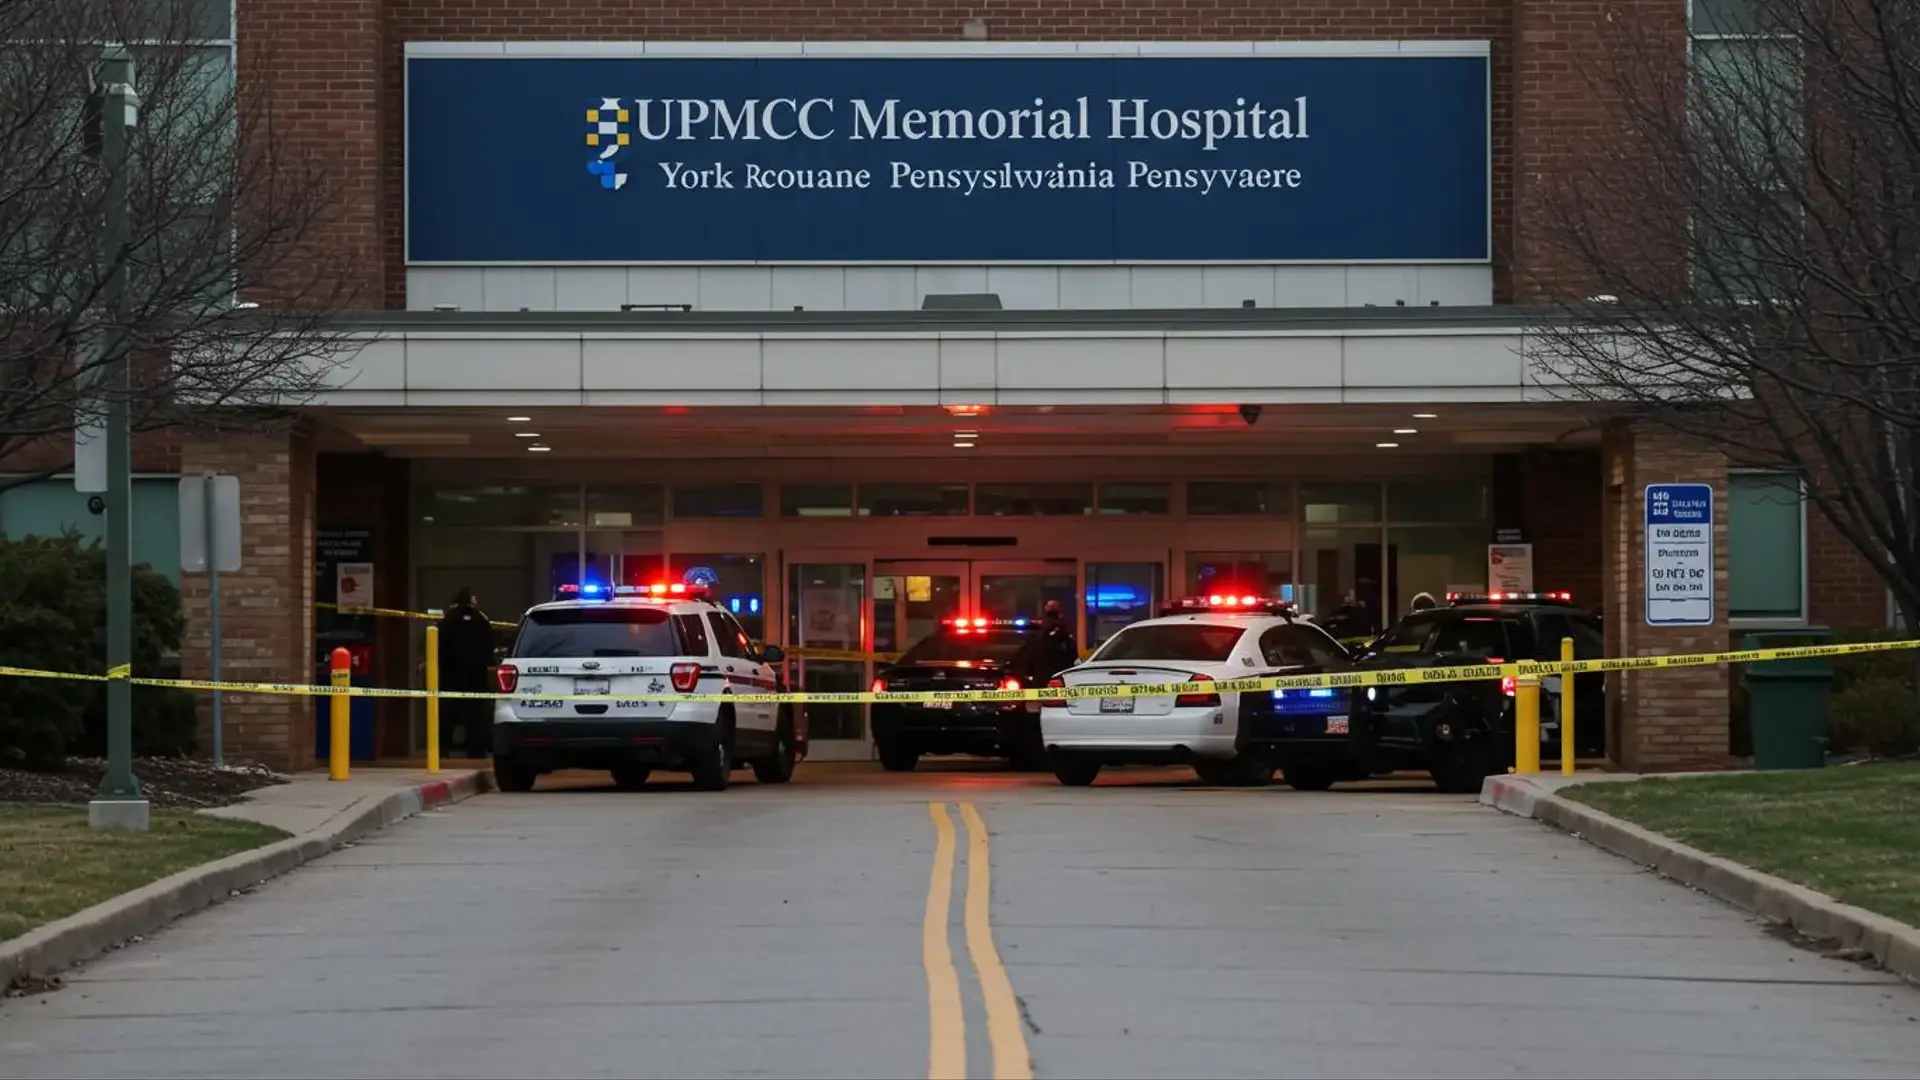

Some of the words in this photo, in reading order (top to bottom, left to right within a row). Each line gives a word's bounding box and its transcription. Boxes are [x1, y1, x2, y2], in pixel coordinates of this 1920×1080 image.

[634, 98, 835, 141] UPMCC
[849, 96, 1091, 141] Memorial
[1107, 95, 1309, 151] Hospital
[658, 161, 734, 190] York
[1127, 160, 1302, 196] Pensyvaere
